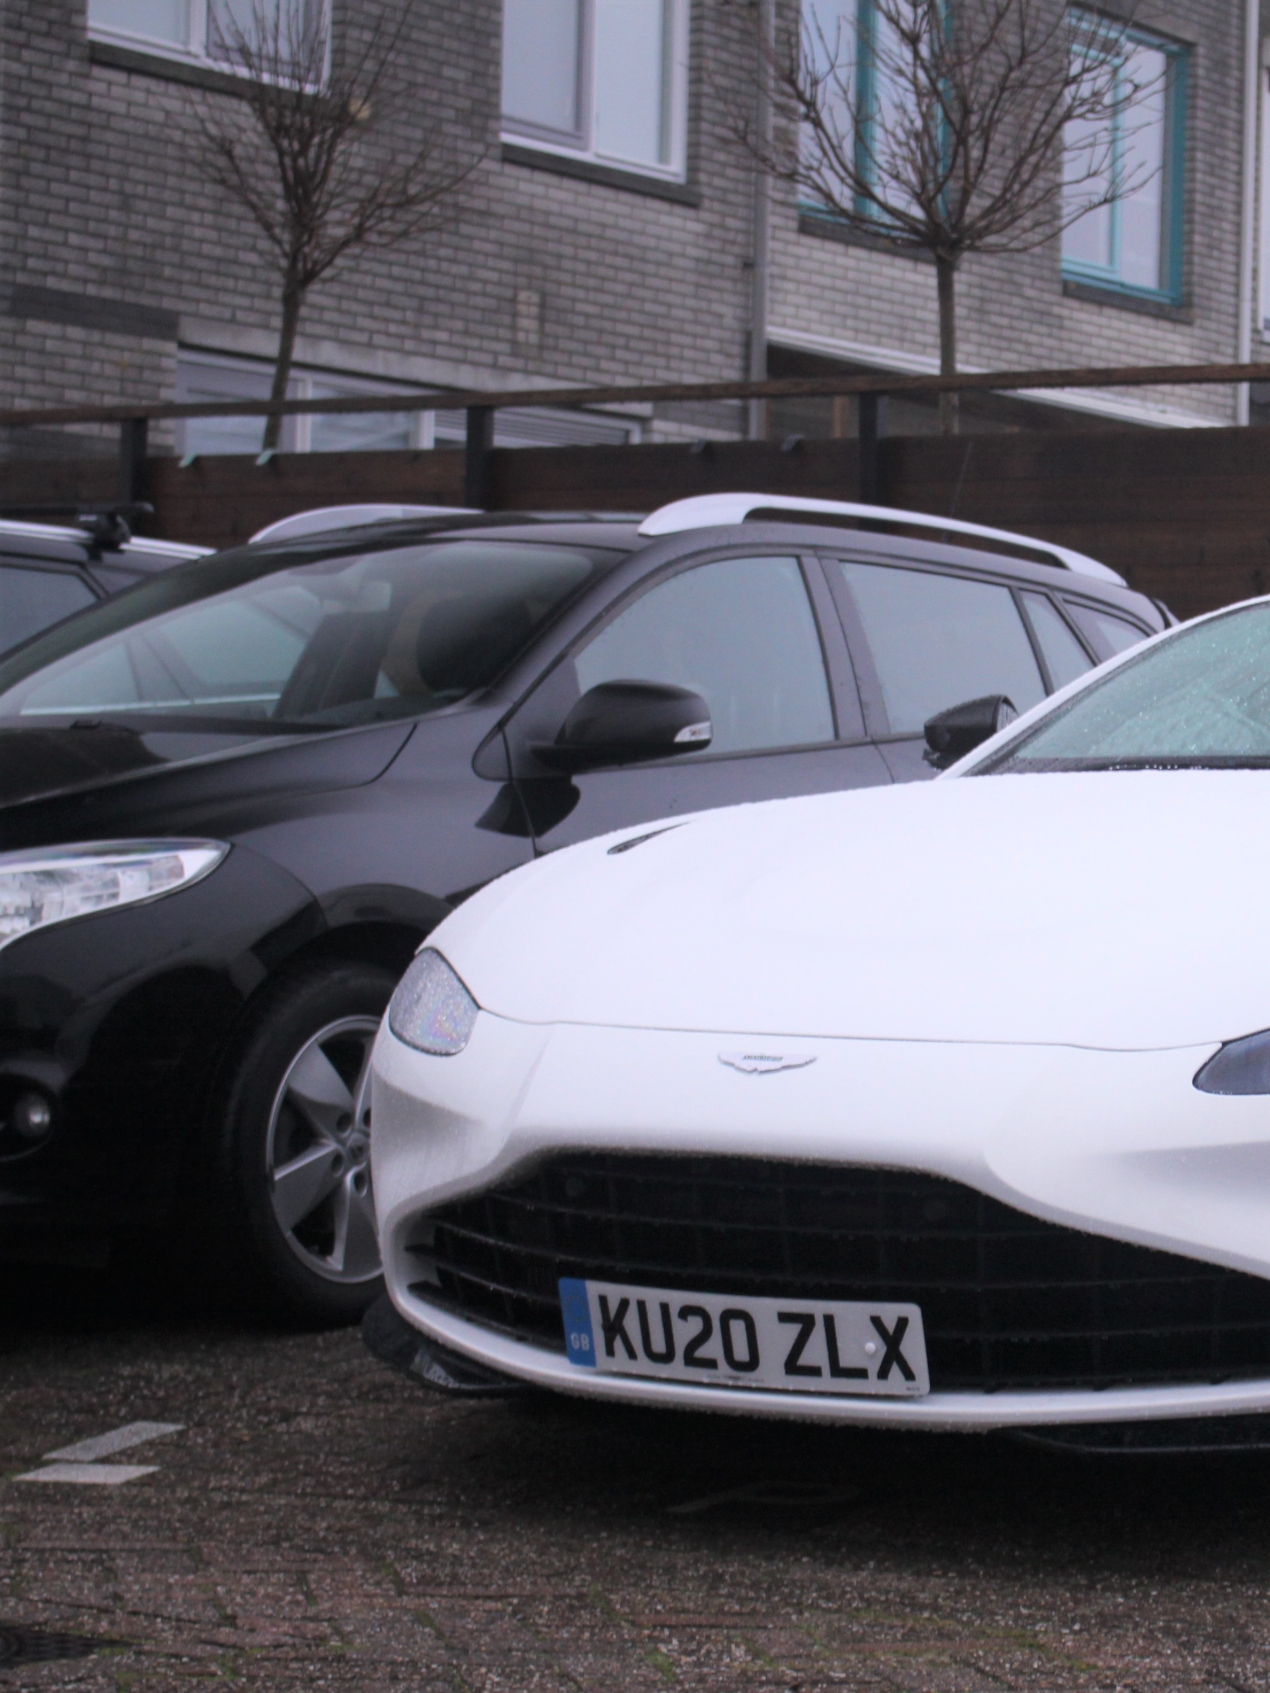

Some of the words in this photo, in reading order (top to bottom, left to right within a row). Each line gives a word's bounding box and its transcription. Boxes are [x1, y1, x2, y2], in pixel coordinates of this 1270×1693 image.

[570, 1332, 591, 1351] GB
[597, 1294, 761, 1373] KU20
[776, 1311, 917, 1382] ZLX
